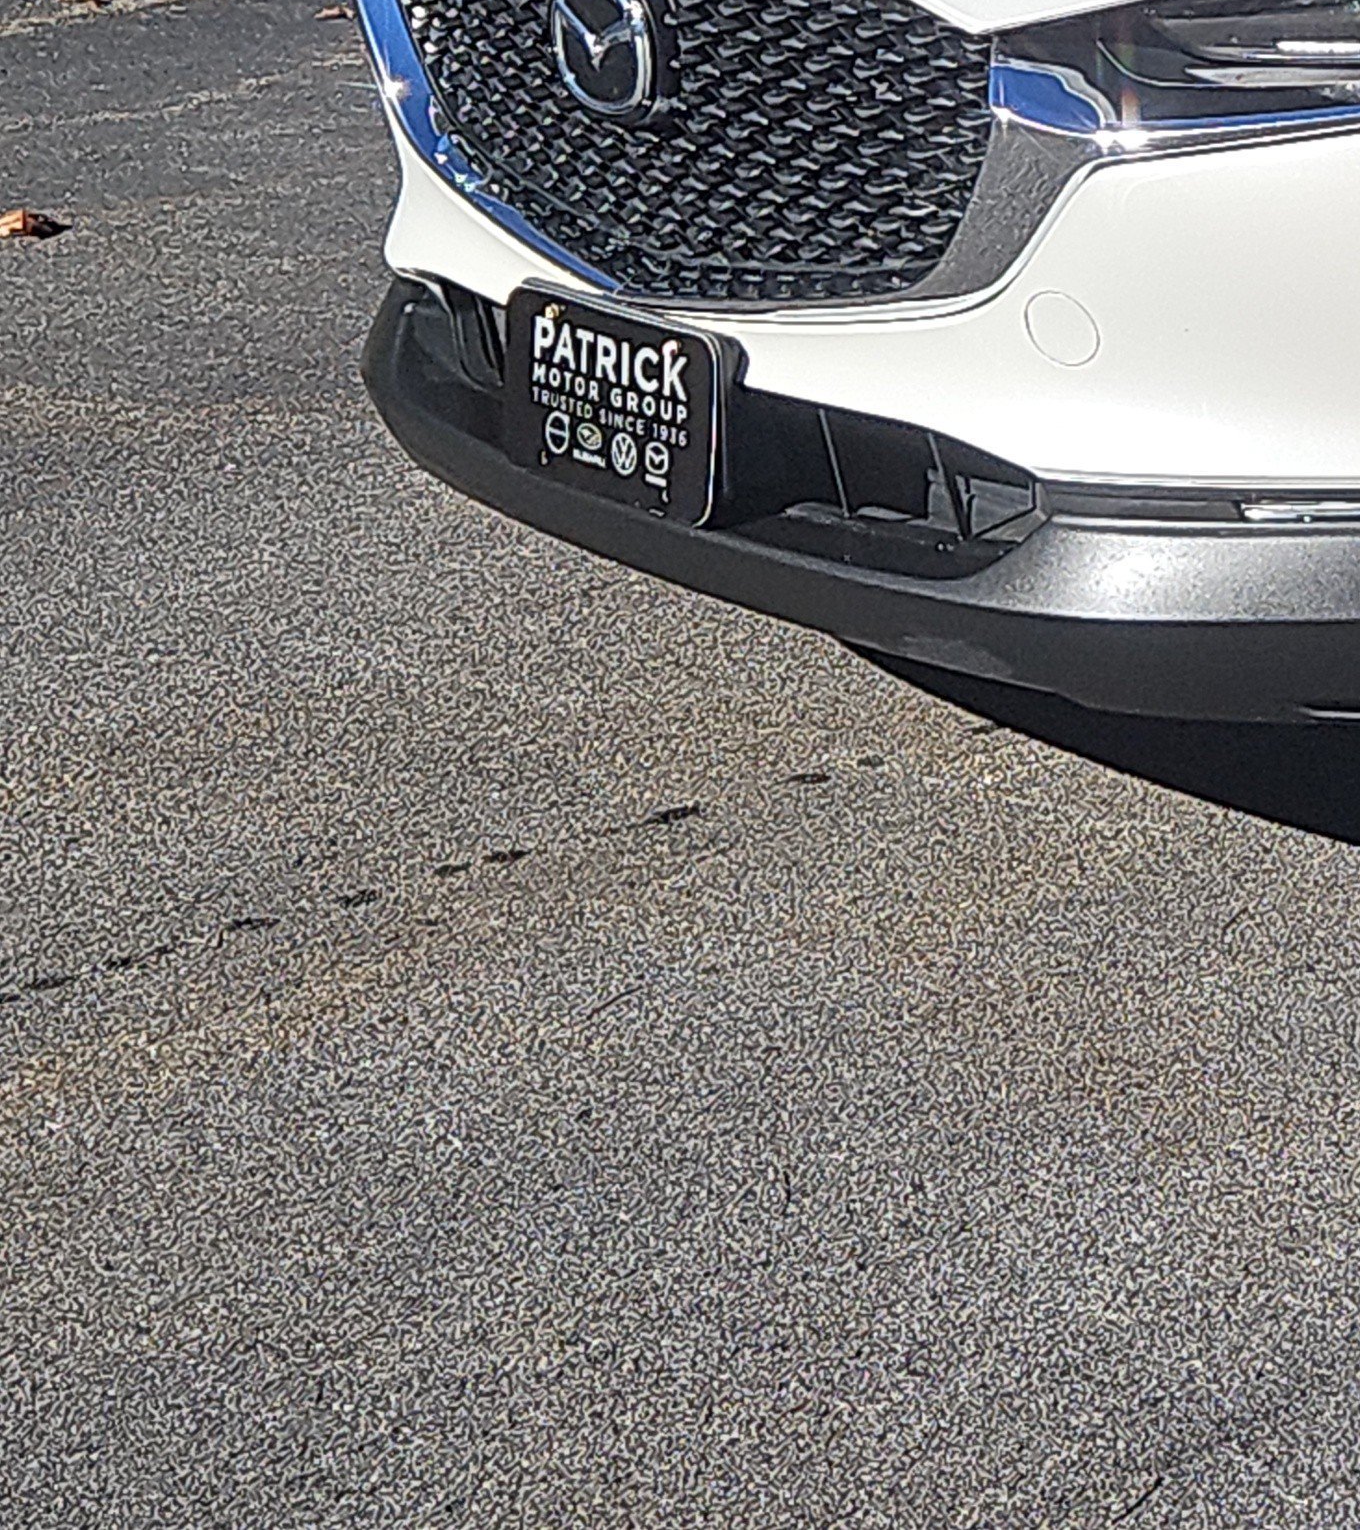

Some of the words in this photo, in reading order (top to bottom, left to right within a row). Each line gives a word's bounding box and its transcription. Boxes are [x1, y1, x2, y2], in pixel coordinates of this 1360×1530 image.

[533, 316, 688, 402] PATRICK
[532, 362, 600, 402] MOTOR
[610, 387, 688, 424] GROUP
[532, 386, 593, 419] TRUSTED
[599, 408, 645, 436] SINCE
